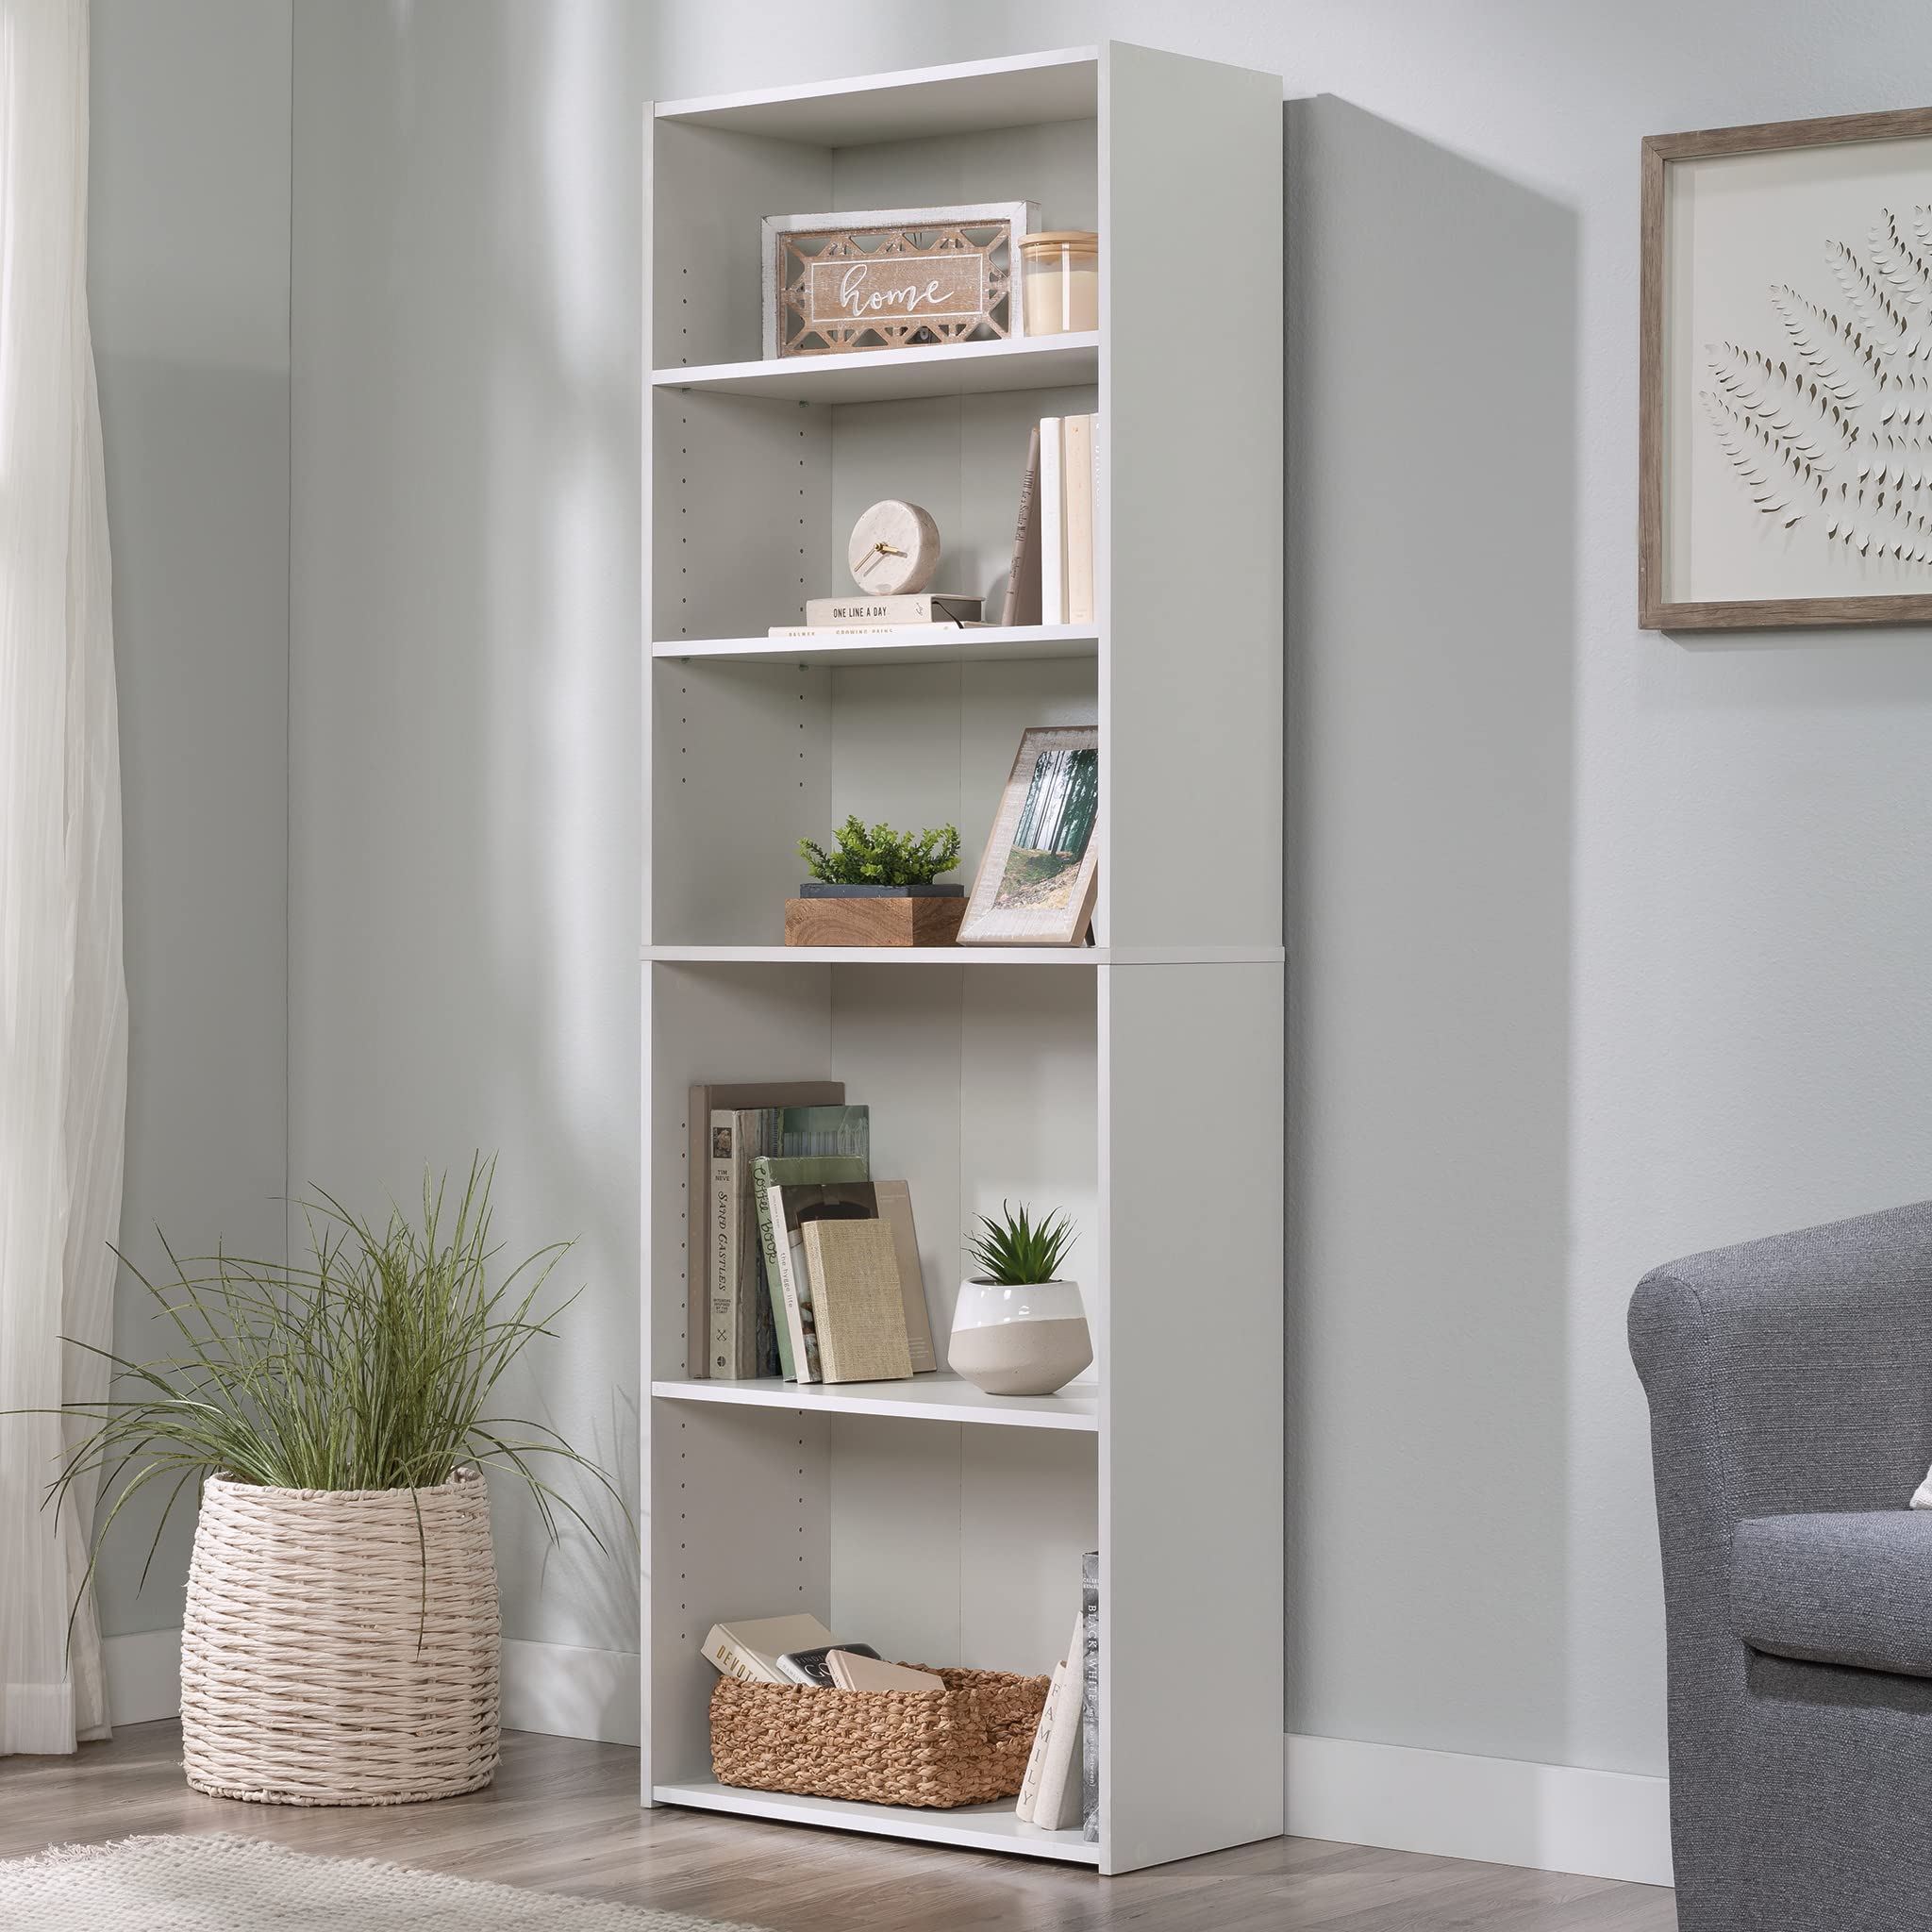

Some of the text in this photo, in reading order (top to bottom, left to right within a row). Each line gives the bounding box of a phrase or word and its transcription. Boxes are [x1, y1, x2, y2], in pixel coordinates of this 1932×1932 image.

[840, 263, 955, 317] home
[833, 607, 887, 618] ONE LINE A DAY
[1088, 1605, 1097, 1648] BLACK
[1088, 1658, 1097, 1701] WHITE
[1024, 1684, 1060, 1806] FAMILY
